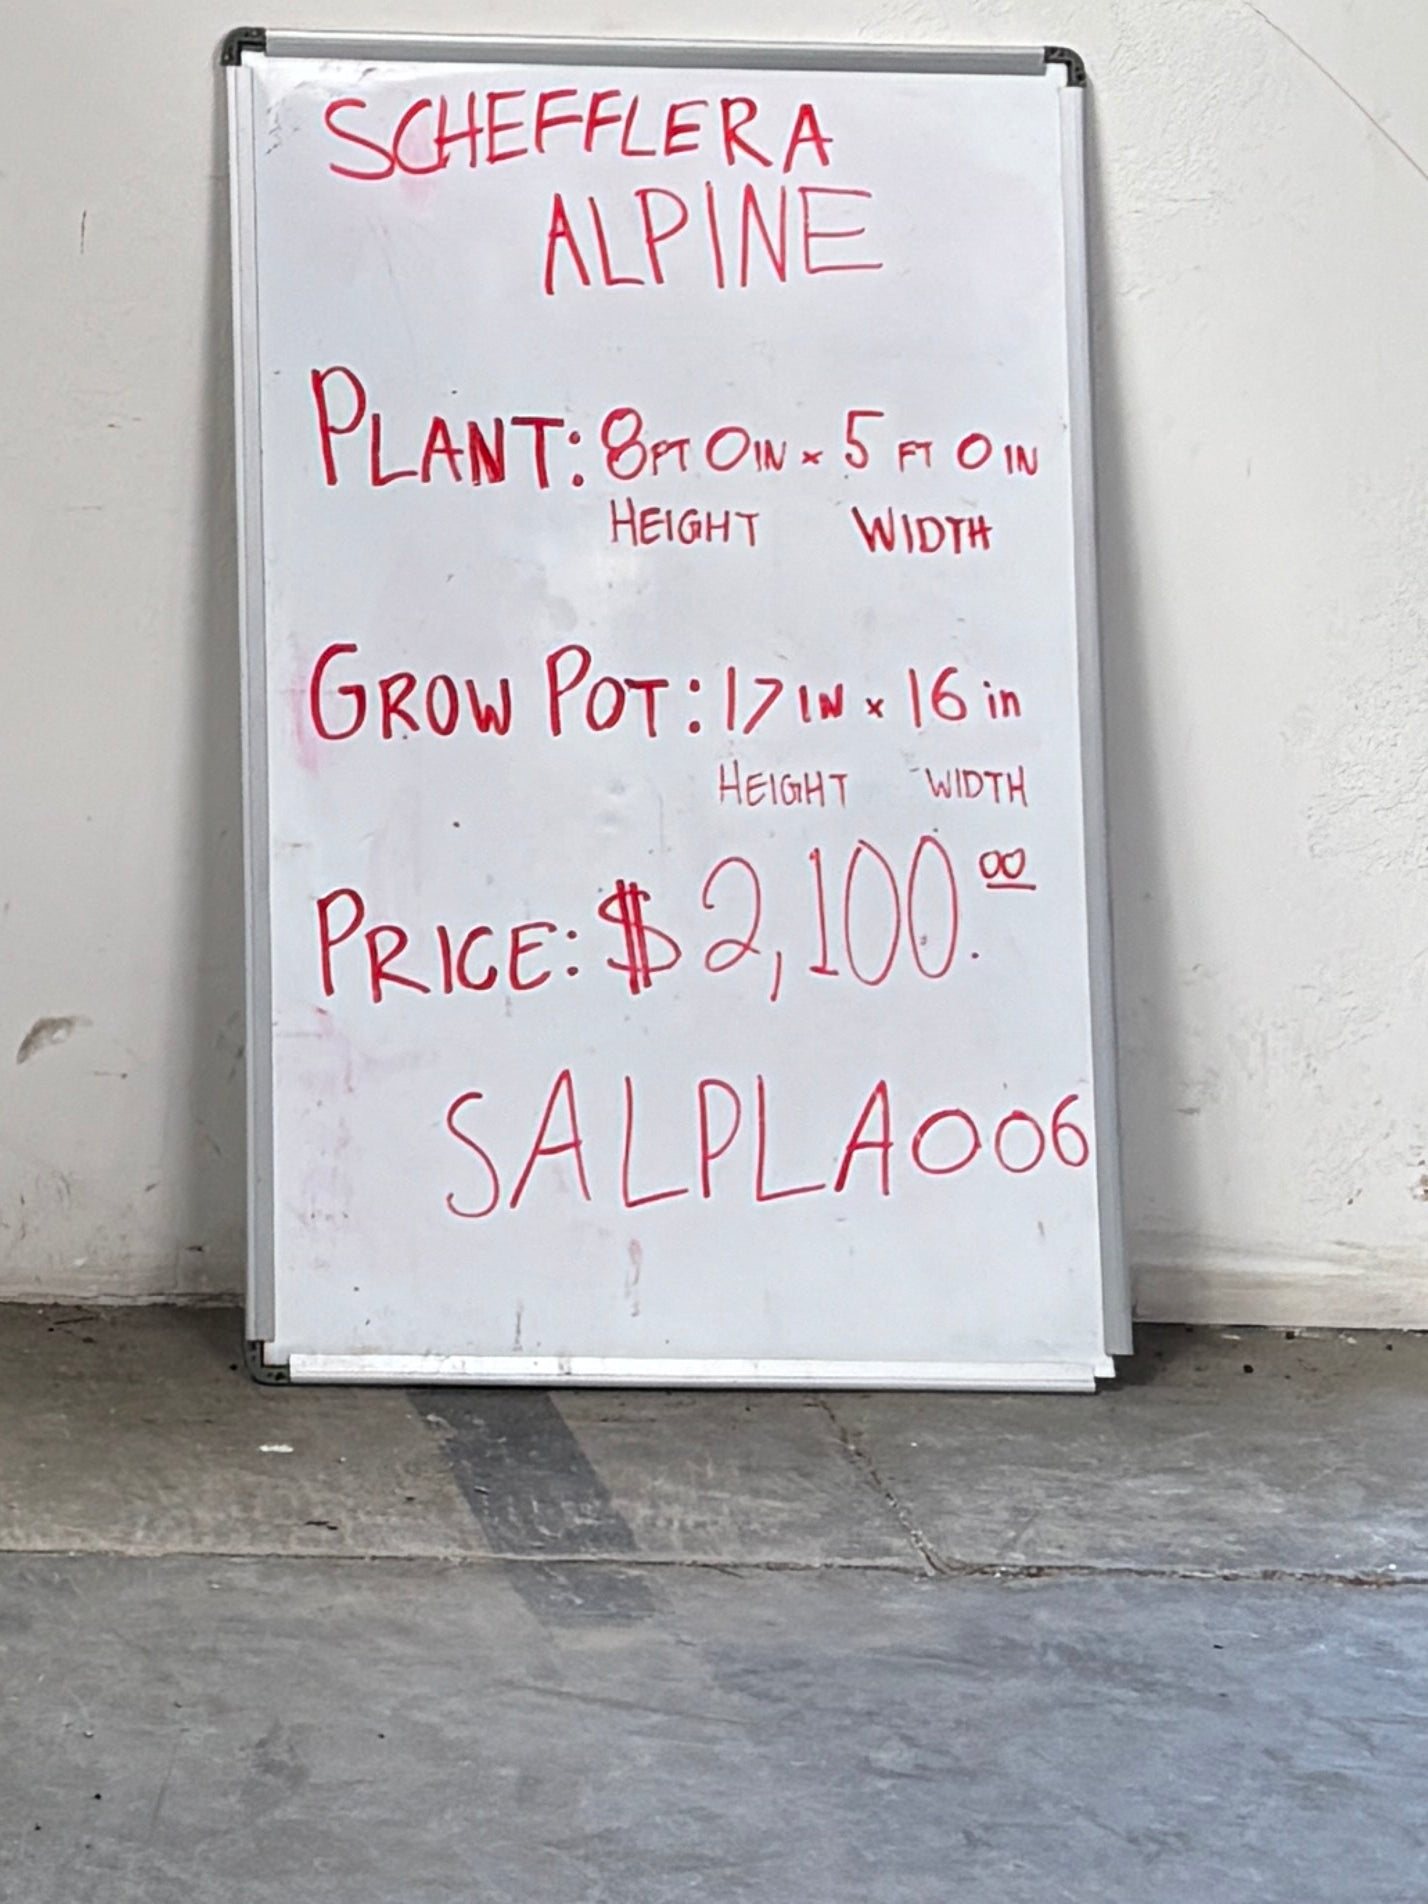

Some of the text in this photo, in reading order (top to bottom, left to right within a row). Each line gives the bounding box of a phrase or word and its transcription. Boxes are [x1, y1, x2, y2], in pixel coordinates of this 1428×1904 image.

[323, 88, 834, 182] SCHEFFLERA
[542, 182, 884, 297] ALPINE
[310, 366, 585, 491] PLANT:
[610, 496, 994, 555] HEIGHT WIDTH
[308, 642, 513, 742] GROW
[544, 644, 702, 738] POT:
[719, 759, 1029, 808] HEIGHT WIDTH
[316, 887, 580, 1004] PRICE:
[445, 1068, 1090, 1219] SALPLA006
